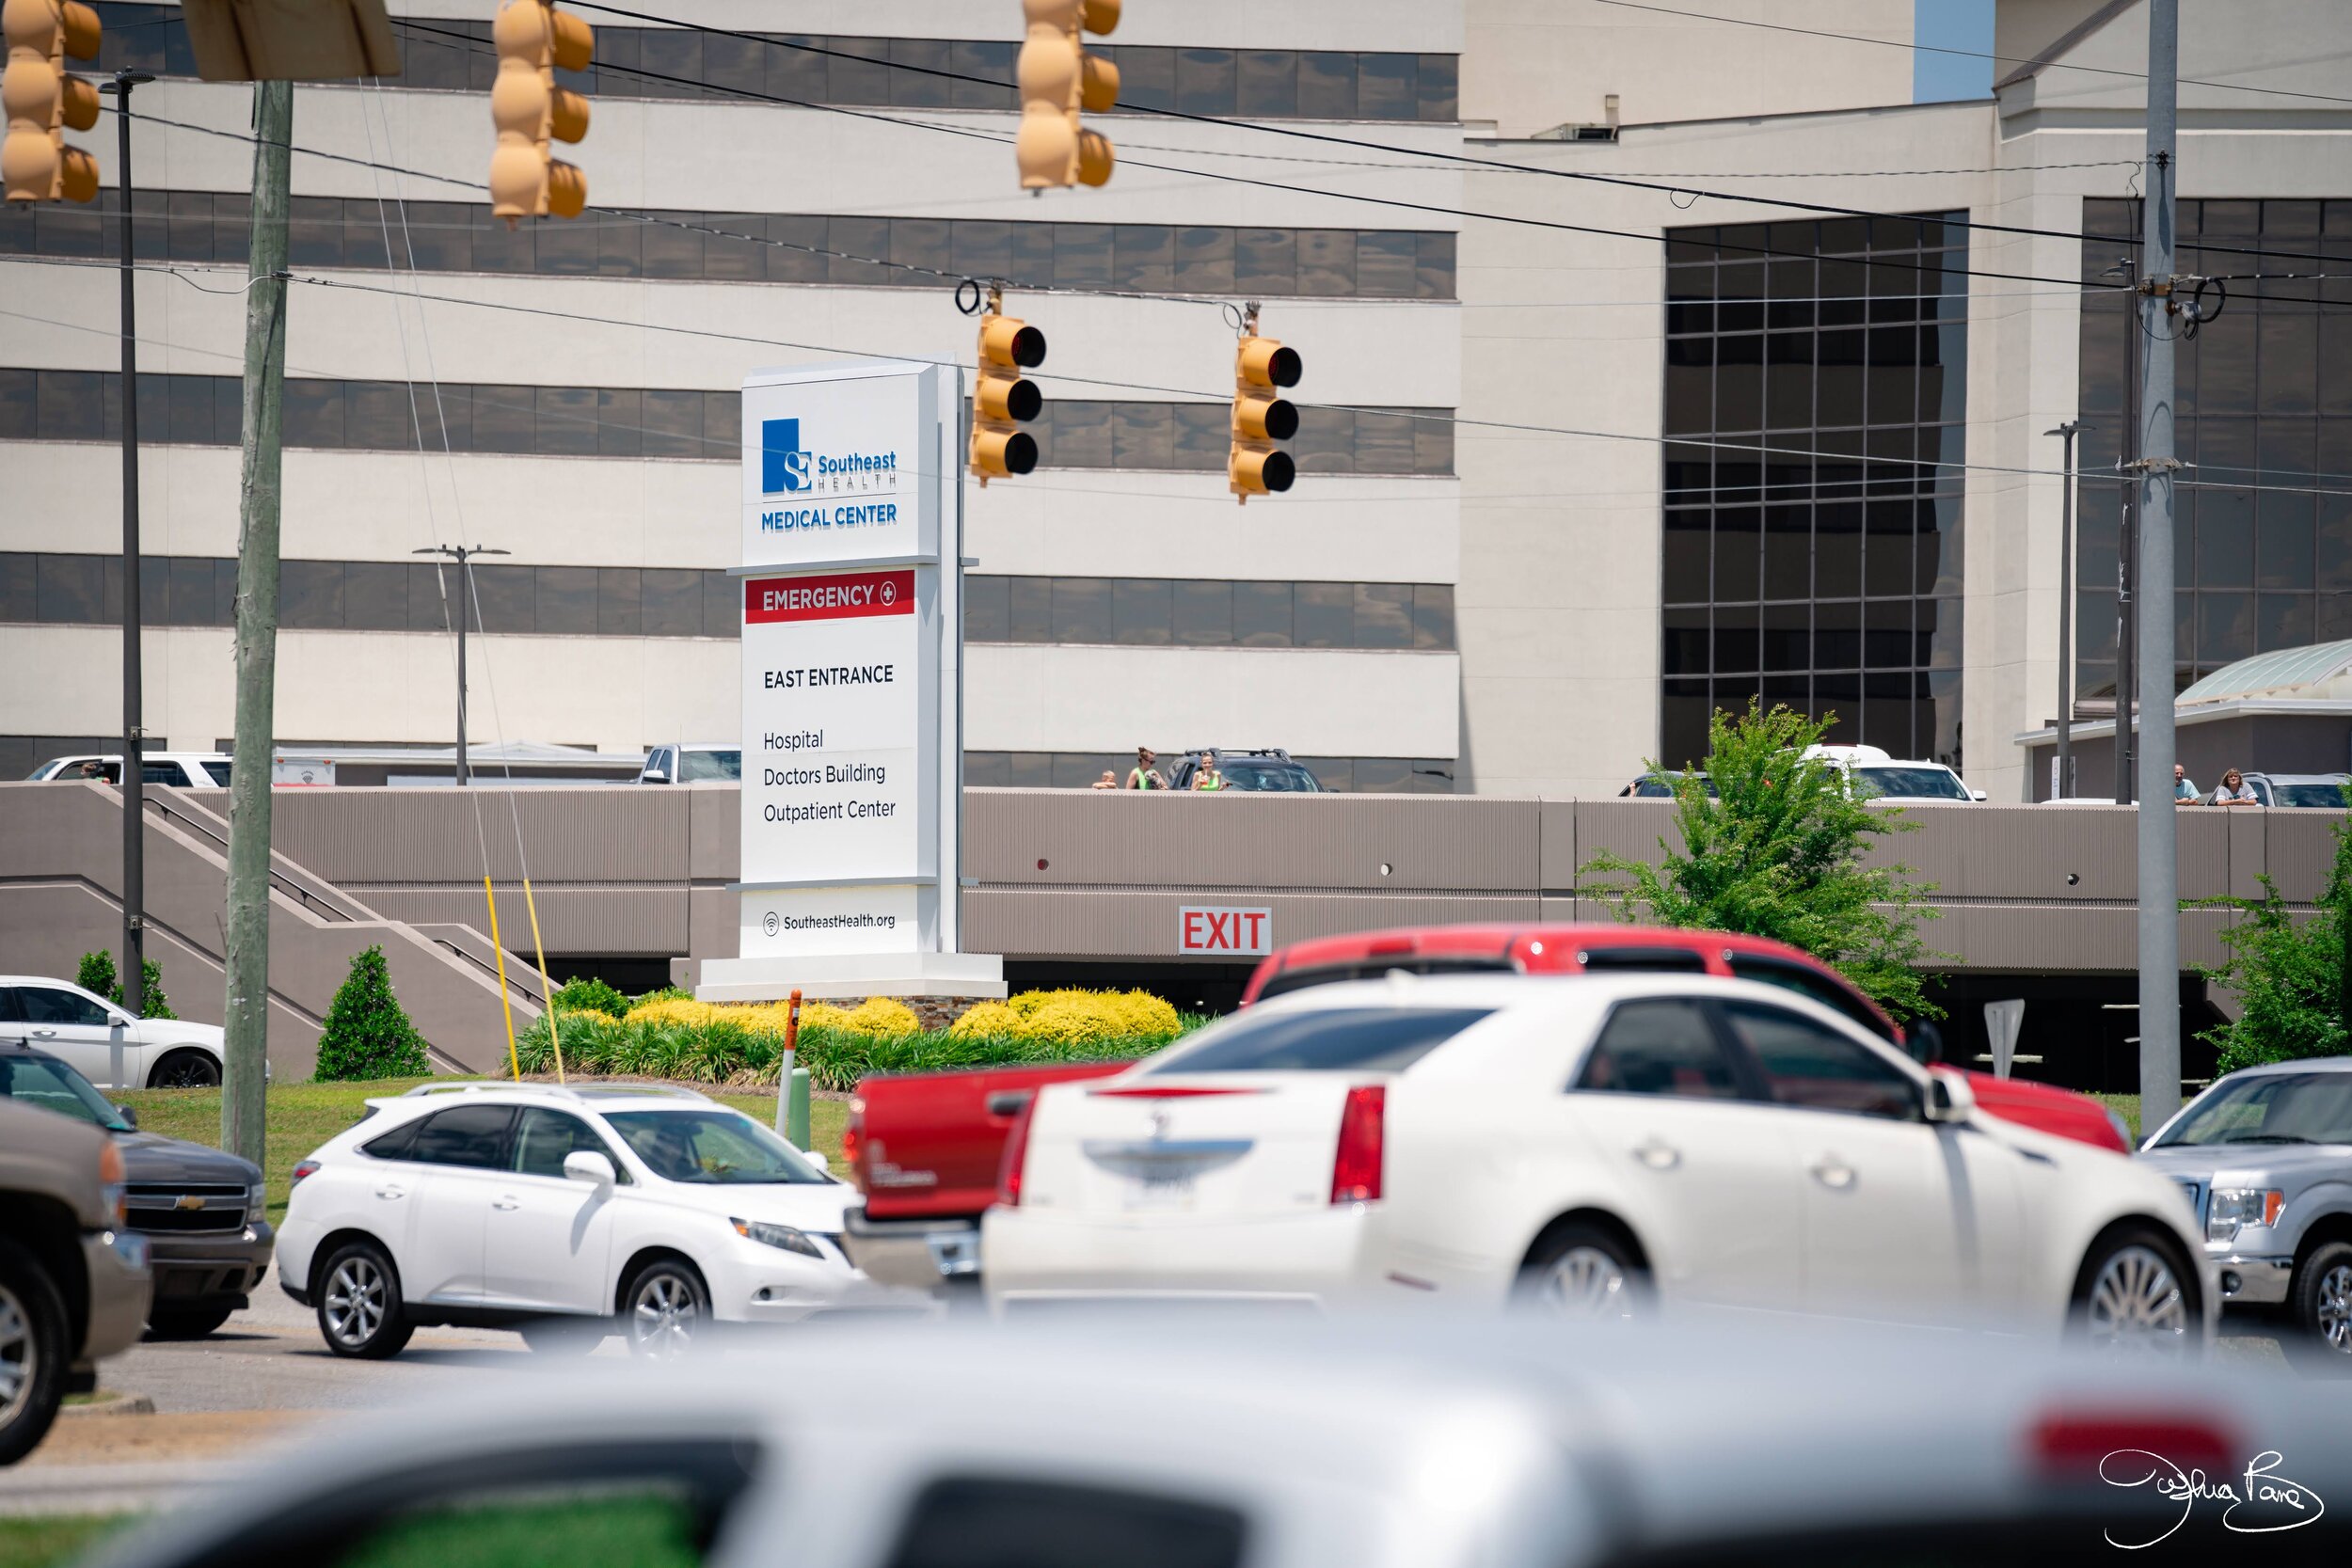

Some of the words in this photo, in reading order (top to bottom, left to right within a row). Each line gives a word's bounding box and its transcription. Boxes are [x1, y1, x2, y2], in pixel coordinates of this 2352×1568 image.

[818, 451, 896, 474] Southeast
[818, 473, 897, 490] HEALTH
[762, 508, 830, 530] MEDICAL
[834, 503, 897, 526] CENTER
[763, 585, 874, 611] EMERGENCY
[764, 670, 803, 689] EAST
[809, 664, 894, 687] ENTRANCE
[764, 729, 823, 752] Hospital
[764, 768, 821, 785] Doctors
[826, 764, 885, 784] Building
[764, 801, 843, 824] Outpatient
[847, 800, 896, 818] Center
[784, 913, 896, 929] SoutheastHealth.org
[1184, 911, 1266, 949] EXIT
